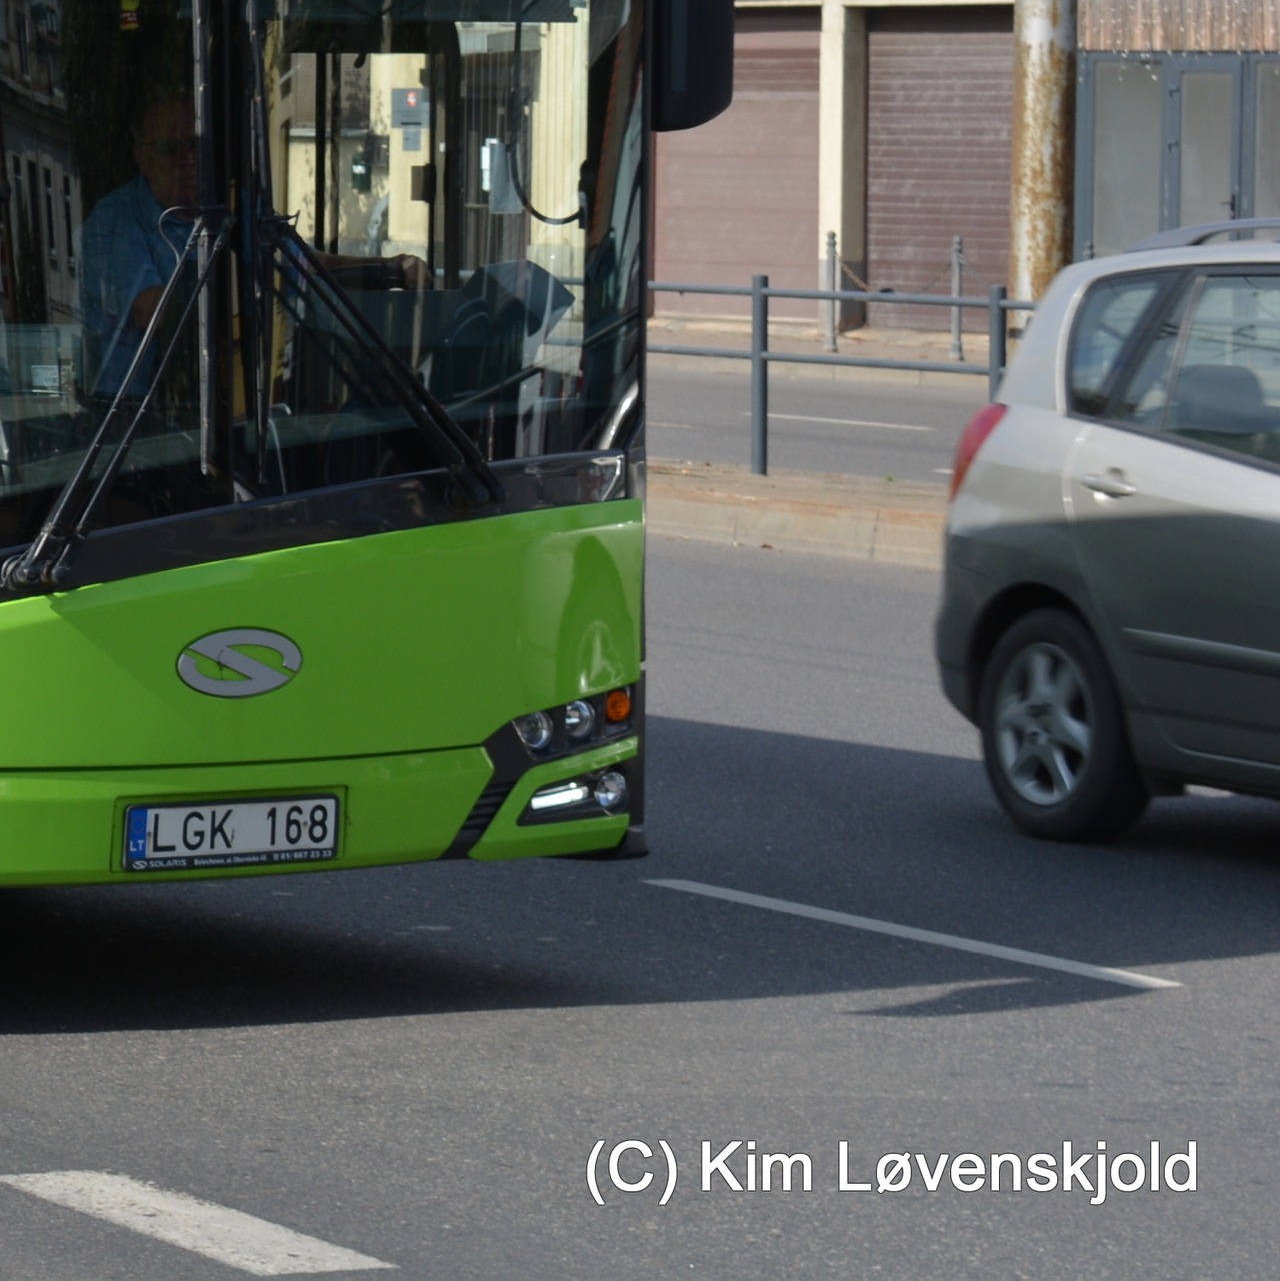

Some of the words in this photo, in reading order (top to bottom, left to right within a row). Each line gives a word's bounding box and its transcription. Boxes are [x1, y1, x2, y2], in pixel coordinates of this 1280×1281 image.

[152, 809, 234, 852] LGK
[267, 804, 328, 846] 168
[130, 840, 145, 852] LT
[149, 859, 187, 868] SOLARIS
